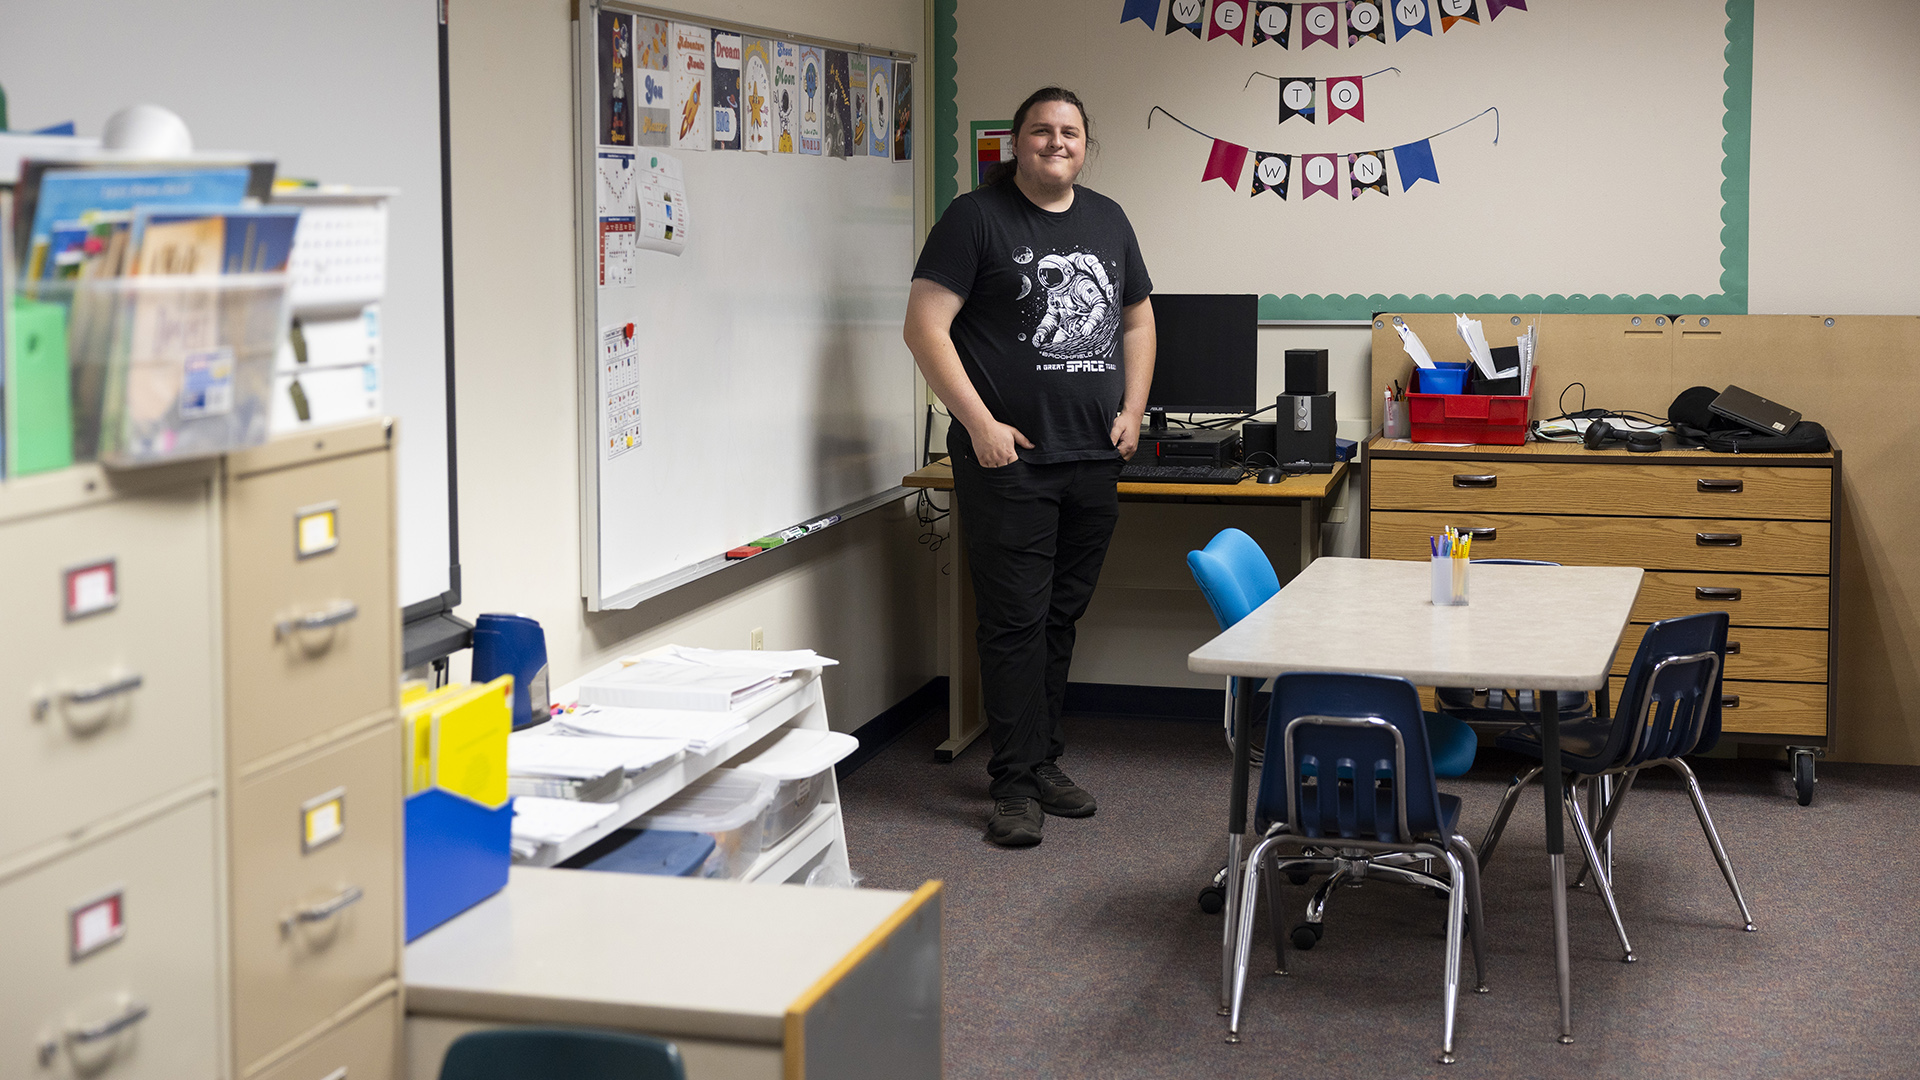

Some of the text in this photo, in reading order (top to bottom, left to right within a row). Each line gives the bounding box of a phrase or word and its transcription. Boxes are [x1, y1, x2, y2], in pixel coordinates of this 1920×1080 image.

[1178, 0, 1463, 29] WELCOME
[716, 41, 740, 60] Dream
[777, 41, 793, 57] Shoot
[775, 65, 796, 87] Moon
[645, 75, 663, 105] You
[1292, 88, 1352, 103] TO
[715, 110, 730, 132] BIG
[1264, 162, 1374, 178] WIN
[1043, 363, 1065, 371] GREAT
[1066, 360, 1105, 372] SPACE
